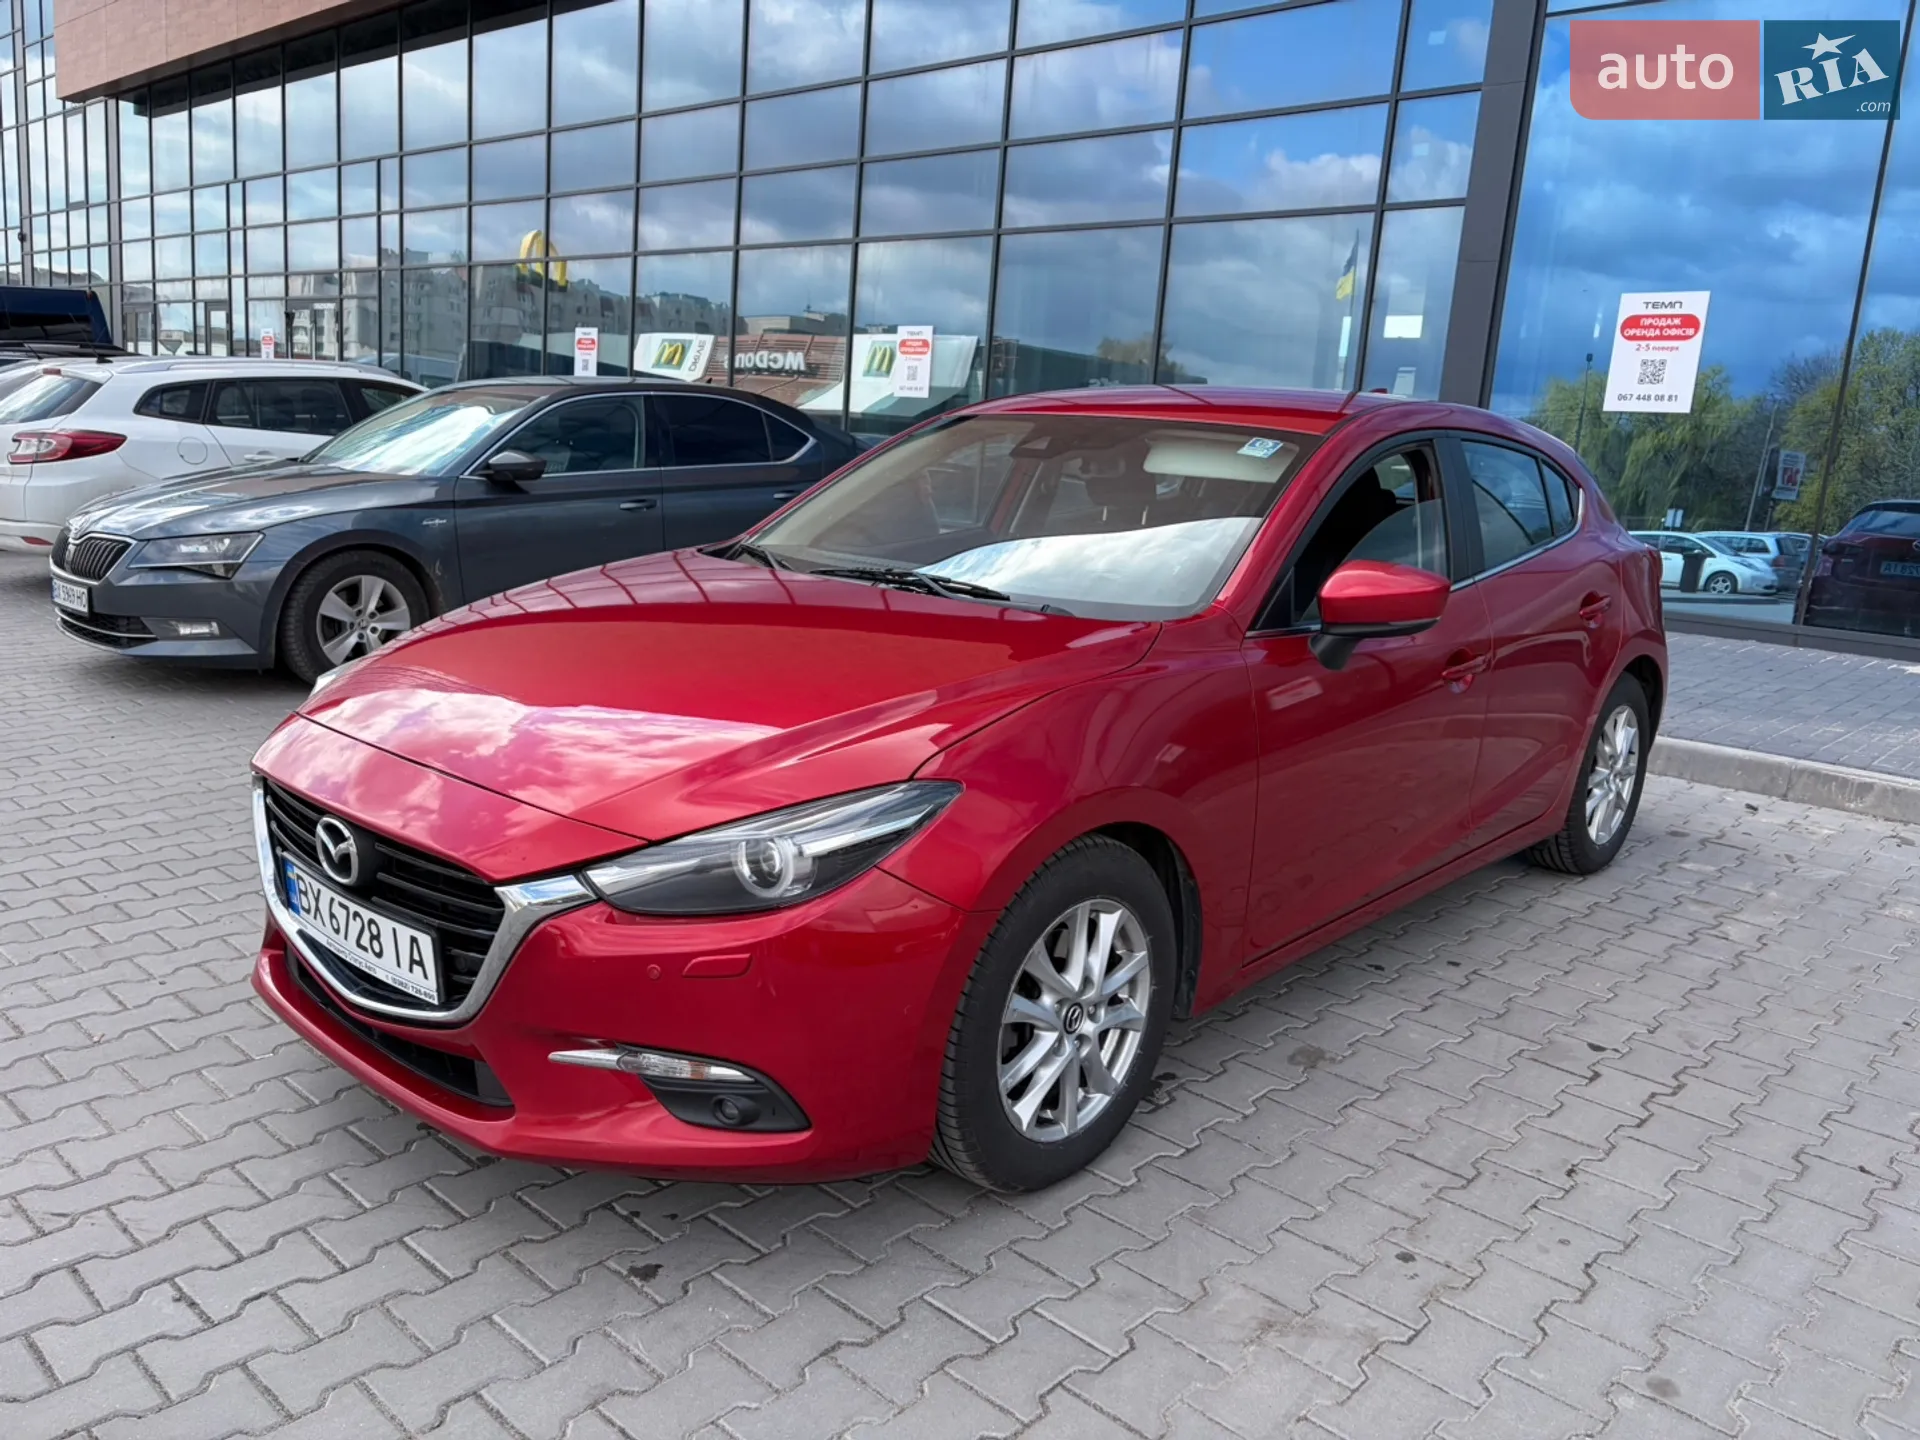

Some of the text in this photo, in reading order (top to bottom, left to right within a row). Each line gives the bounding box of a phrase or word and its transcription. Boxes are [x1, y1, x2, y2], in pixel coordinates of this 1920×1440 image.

[1643, 301, 1683, 310] ТЕМП
[1639, 317, 1682, 327] ПРОДАЖ
[1623, 327, 1695, 338] ОРЕНДА ОФІСІВ
[1635, 343, 1651, 352] 2-5
[1617, 393, 1679, 402] 067 448 08 81
[295, 872, 326, 928] BX
[328, 897, 384, 960] 6728
[392, 926, 429, 981] IA
